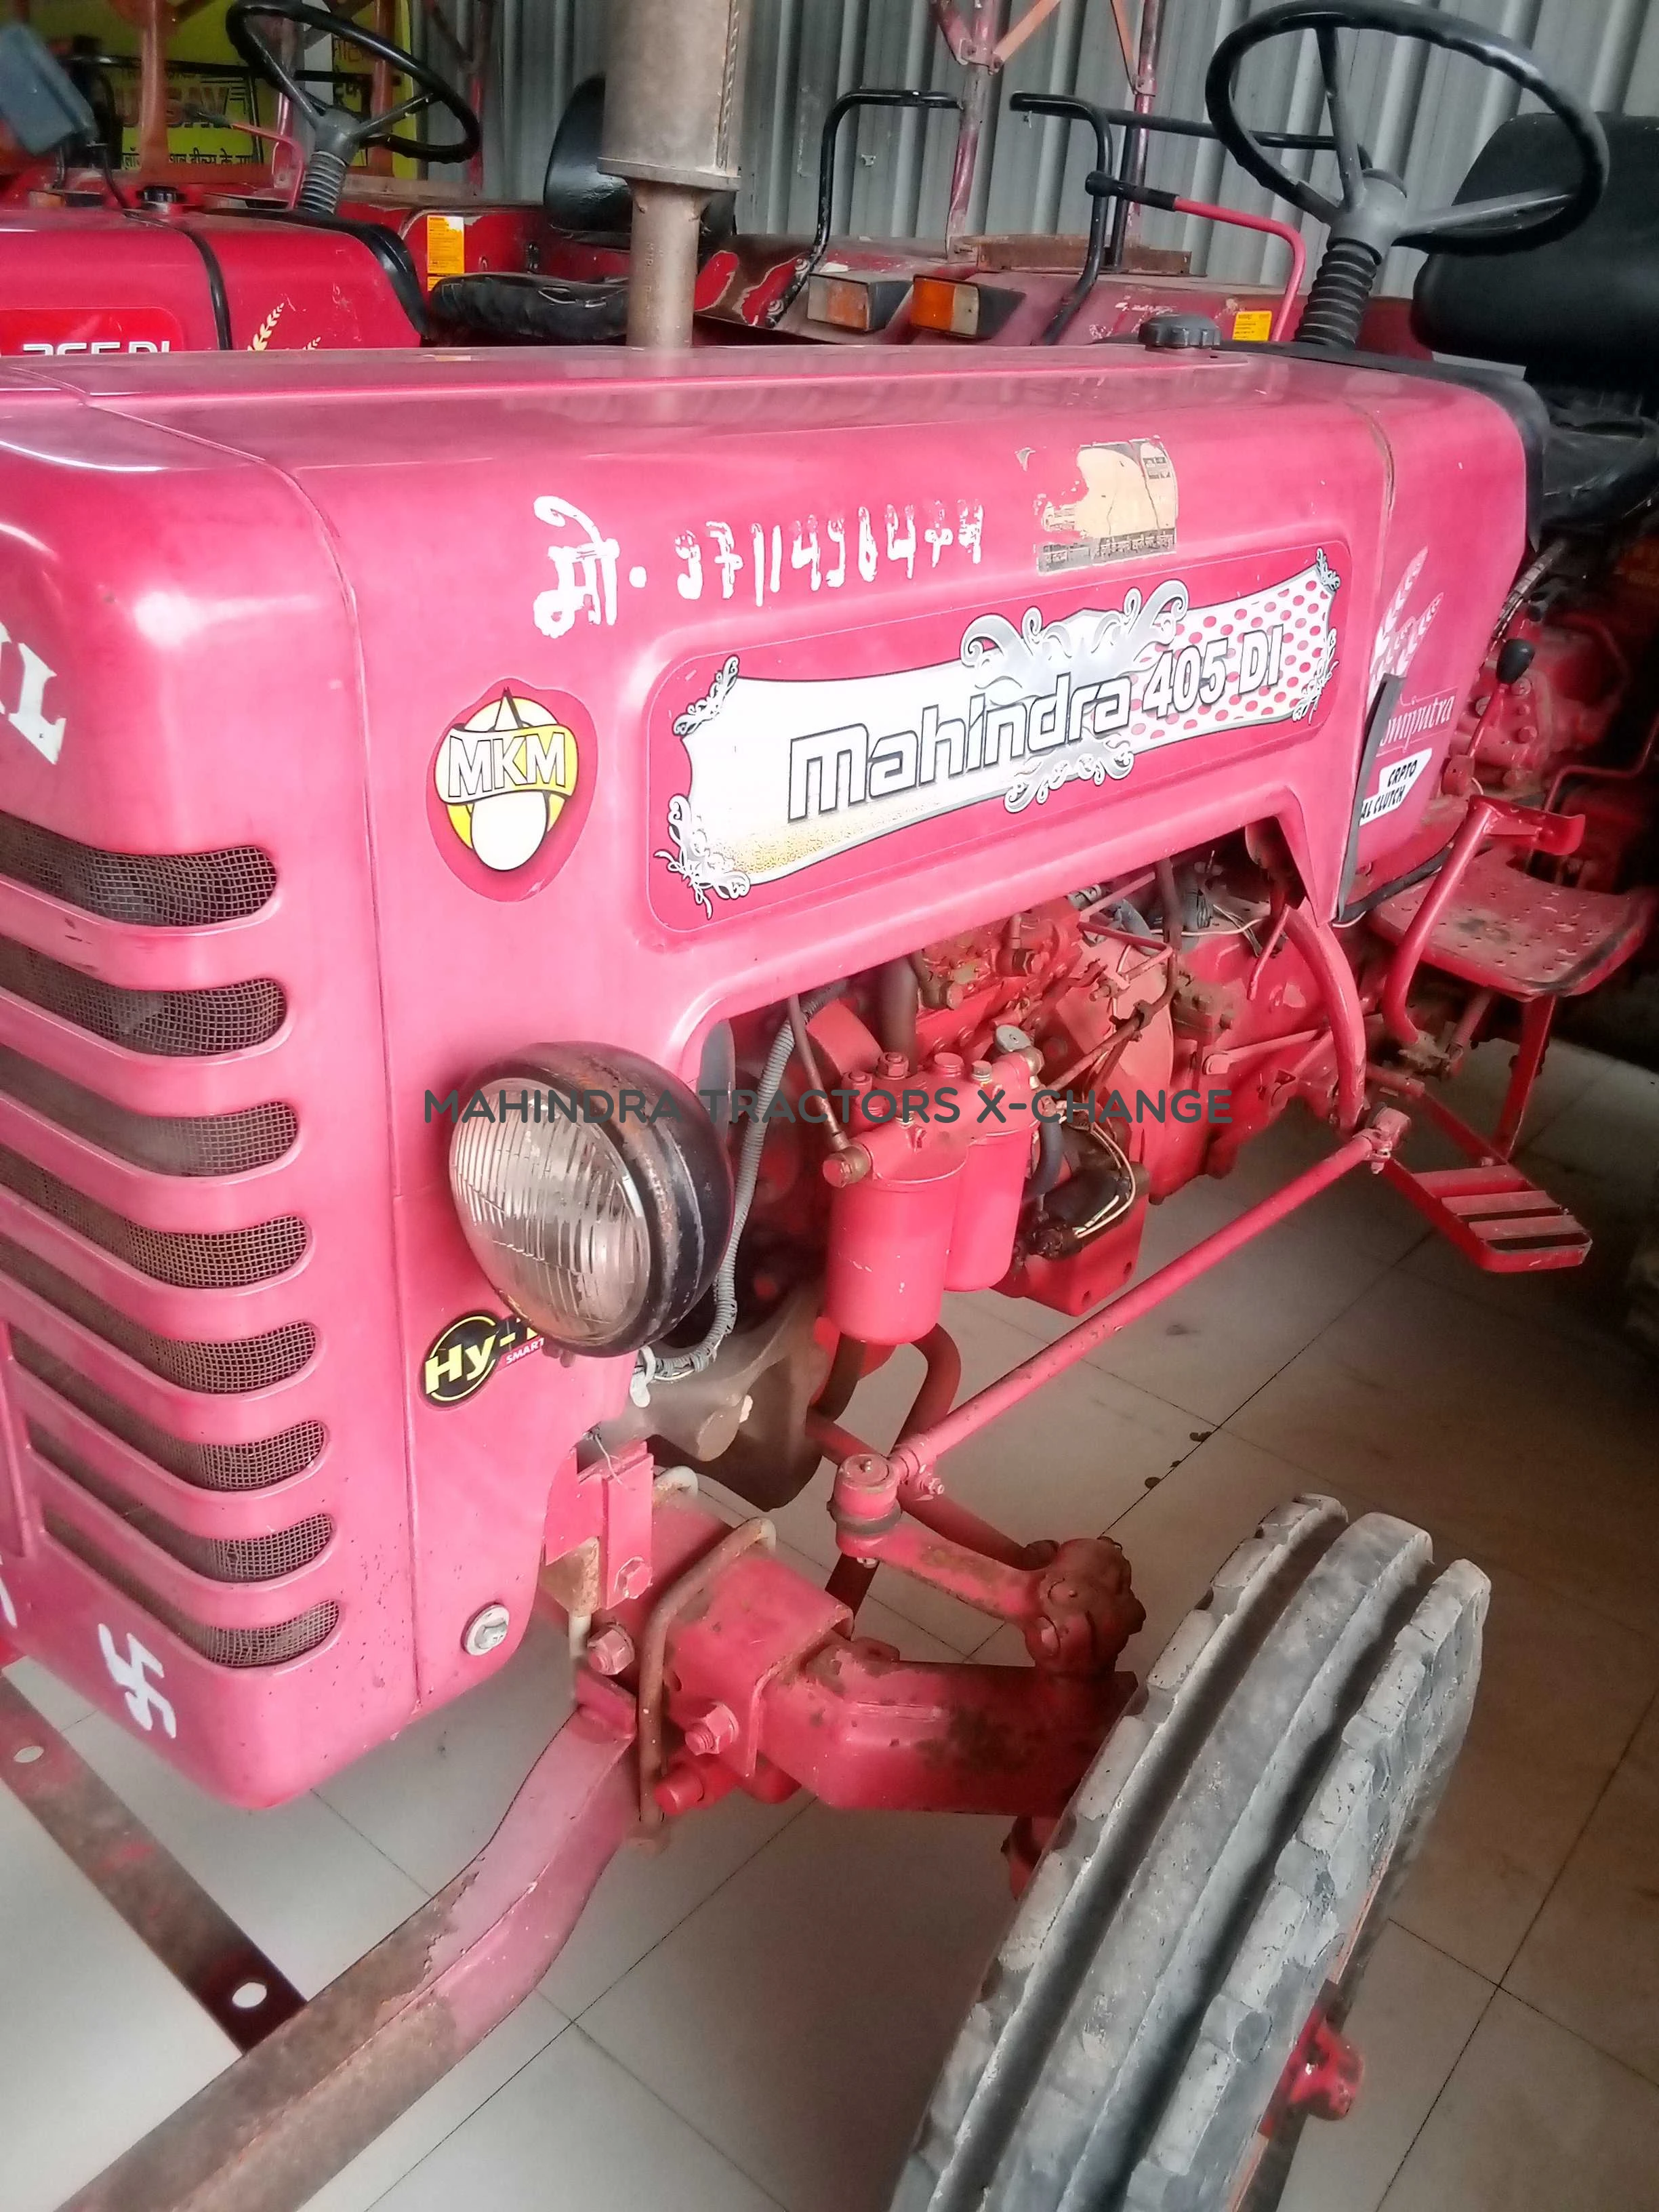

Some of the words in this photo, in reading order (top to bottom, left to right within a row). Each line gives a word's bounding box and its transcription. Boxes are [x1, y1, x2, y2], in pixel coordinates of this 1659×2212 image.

[1142, 637, 1228, 720] 405
[1237, 623, 1284, 695] DI
[448, 731, 566, 798] MKM
[1373, 785, 1406, 814] CLUTCH
[506, 1337, 544, 1365] SMART
